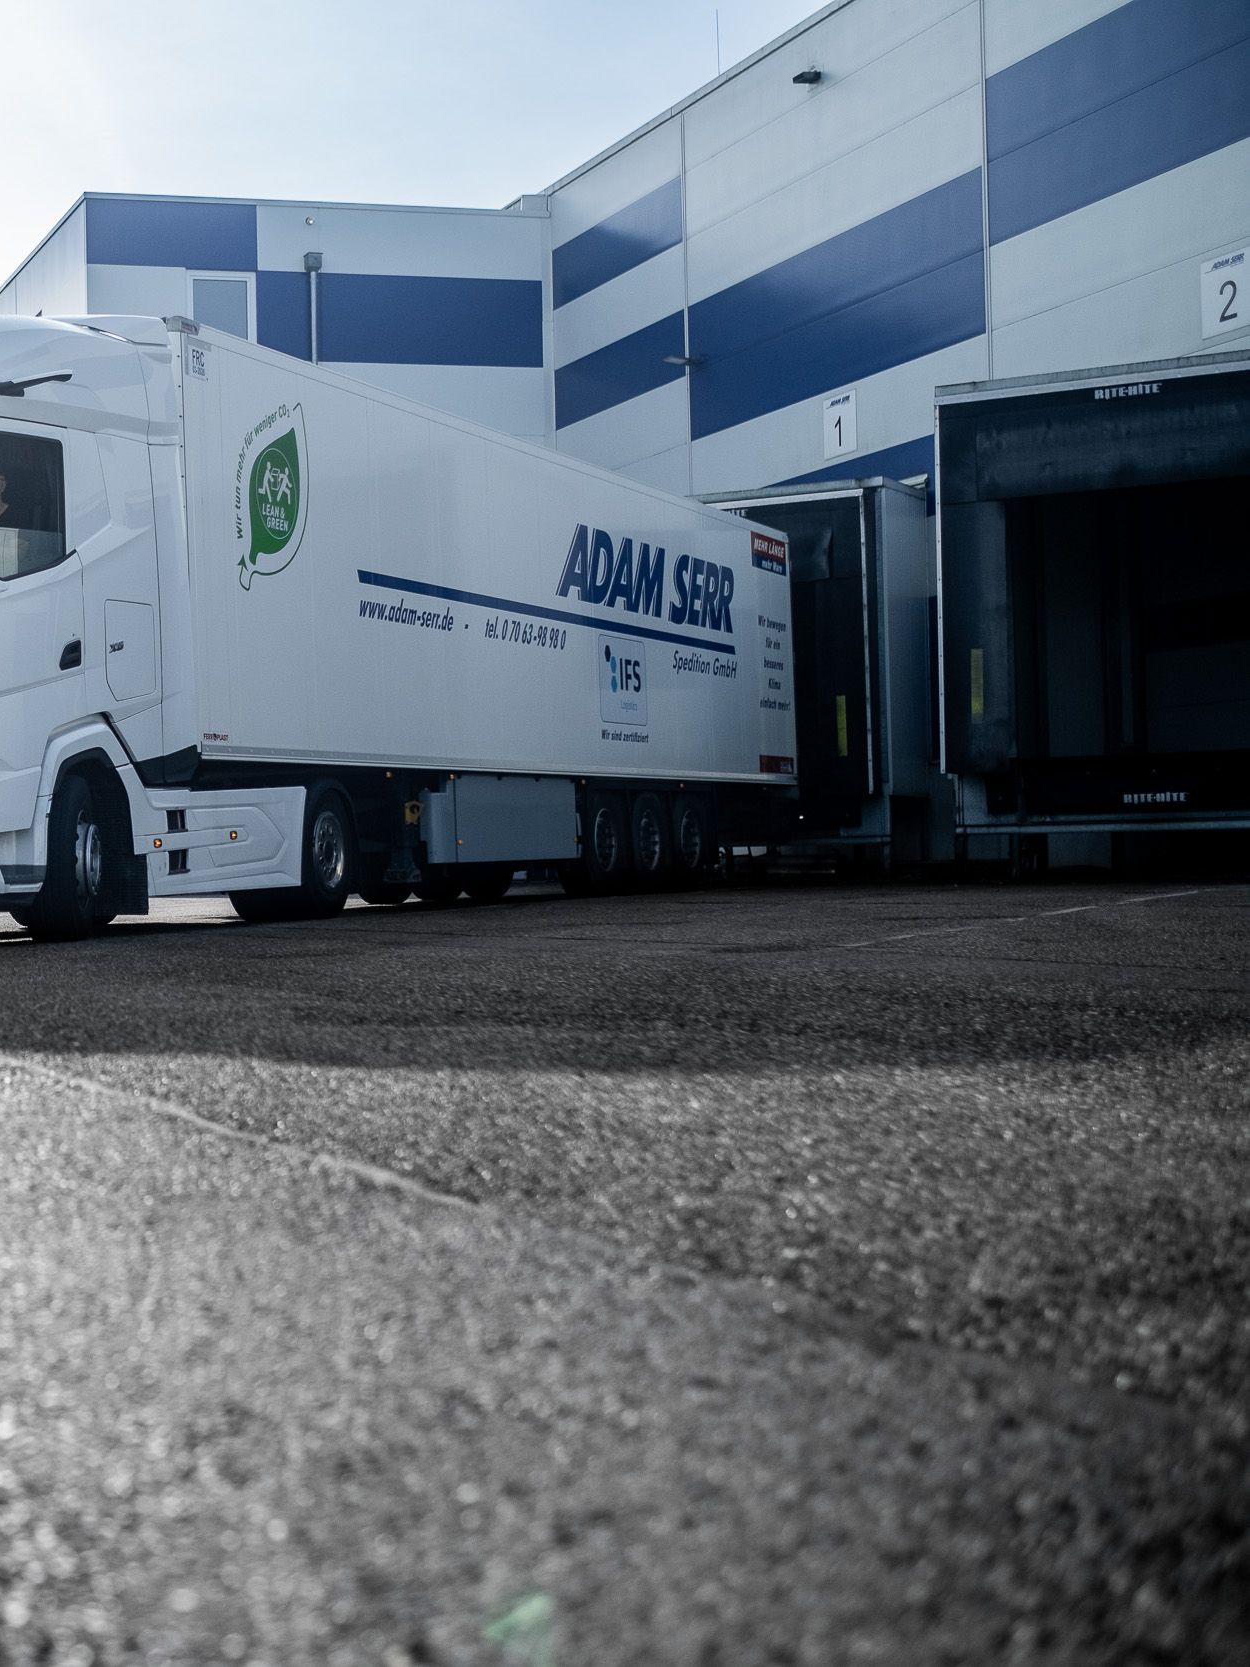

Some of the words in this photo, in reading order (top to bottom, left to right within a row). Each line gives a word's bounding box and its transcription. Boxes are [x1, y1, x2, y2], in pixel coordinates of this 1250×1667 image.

[1219, 280, 1238, 322] 2
[192, 348, 205, 368] FRC
[236, 446, 246, 483] mehr
[244, 432, 254, 449] für
[253, 411, 277, 438] weniger
[834, 415, 842, 447] 1
[262, 503, 280, 518] LEAN
[280, 507, 286, 518] &
[266, 517, 289, 532] GREEN
[754, 537, 768, 554] MEHR
[555, 523, 666, 619] ADAM
[667, 554, 735, 634] SERR
[359, 598, 454, 632] www.adam-serr.de
[484, 616, 499, 640] tel.
[501, 619, 508, 641] 0
[510, 620, 520, 643] 70
[521, 622, 548, 647] 63-98
[549, 627, 560, 650] 98
[560, 629, 567, 651] 0
[619, 658, 642, 693] IFS
[672, 650, 711, 675] Spedition
[712, 656, 737, 680] GmbH
